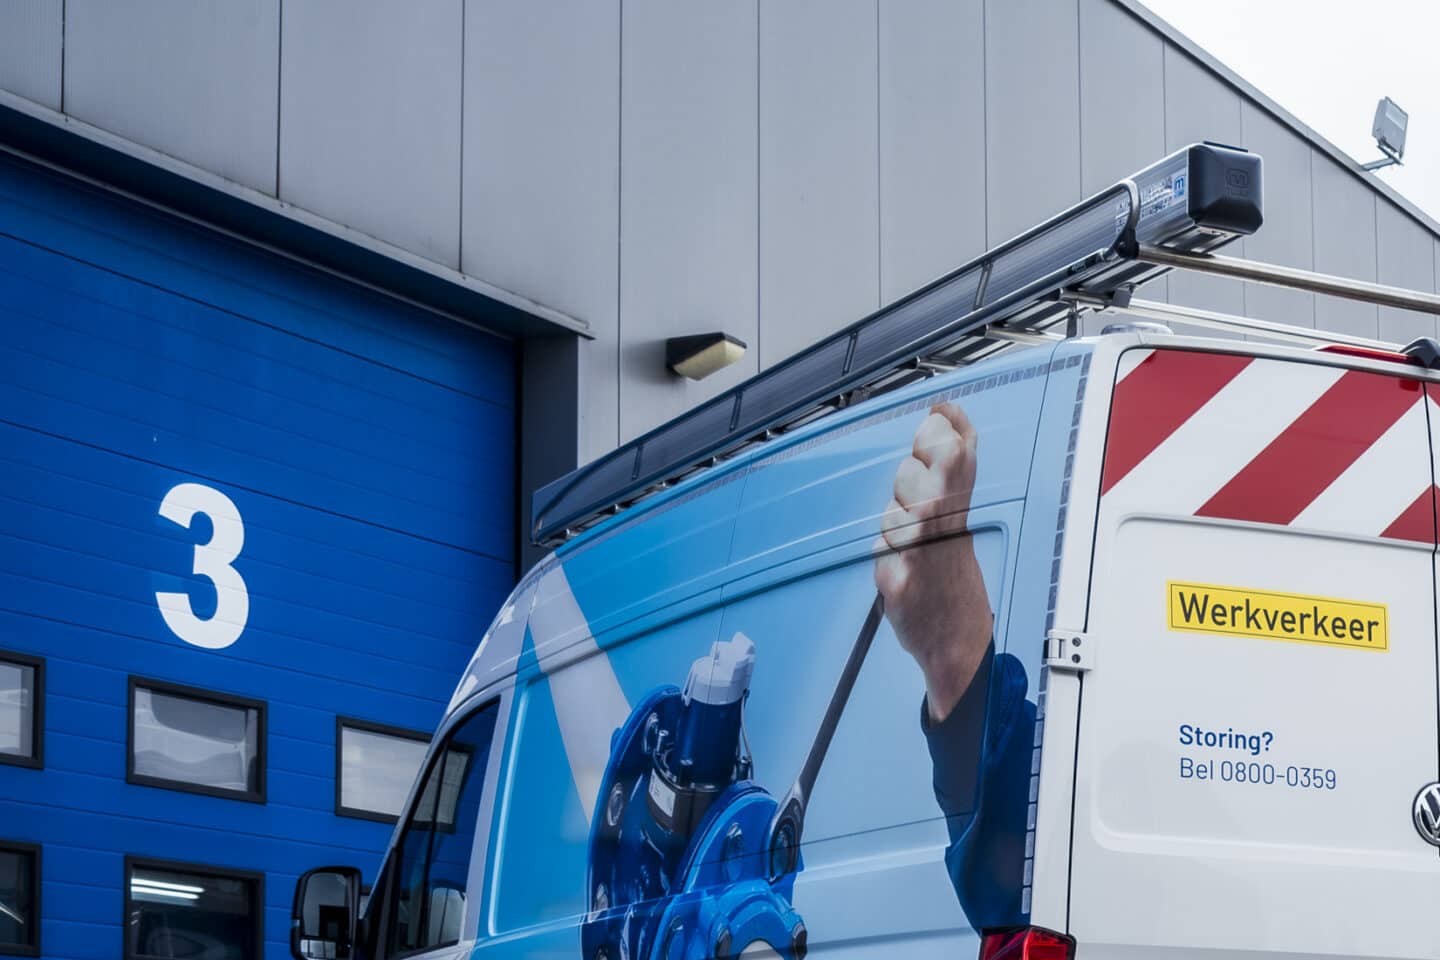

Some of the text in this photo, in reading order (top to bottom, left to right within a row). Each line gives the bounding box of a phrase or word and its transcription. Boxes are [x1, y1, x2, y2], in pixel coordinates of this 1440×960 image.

[155, 483, 249, 649] 3
[1178, 592, 1380, 643] Werkverkeer
[1179, 724, 1274, 755] Storing?
[1179, 757, 1337, 790] Bel 0800-0359
